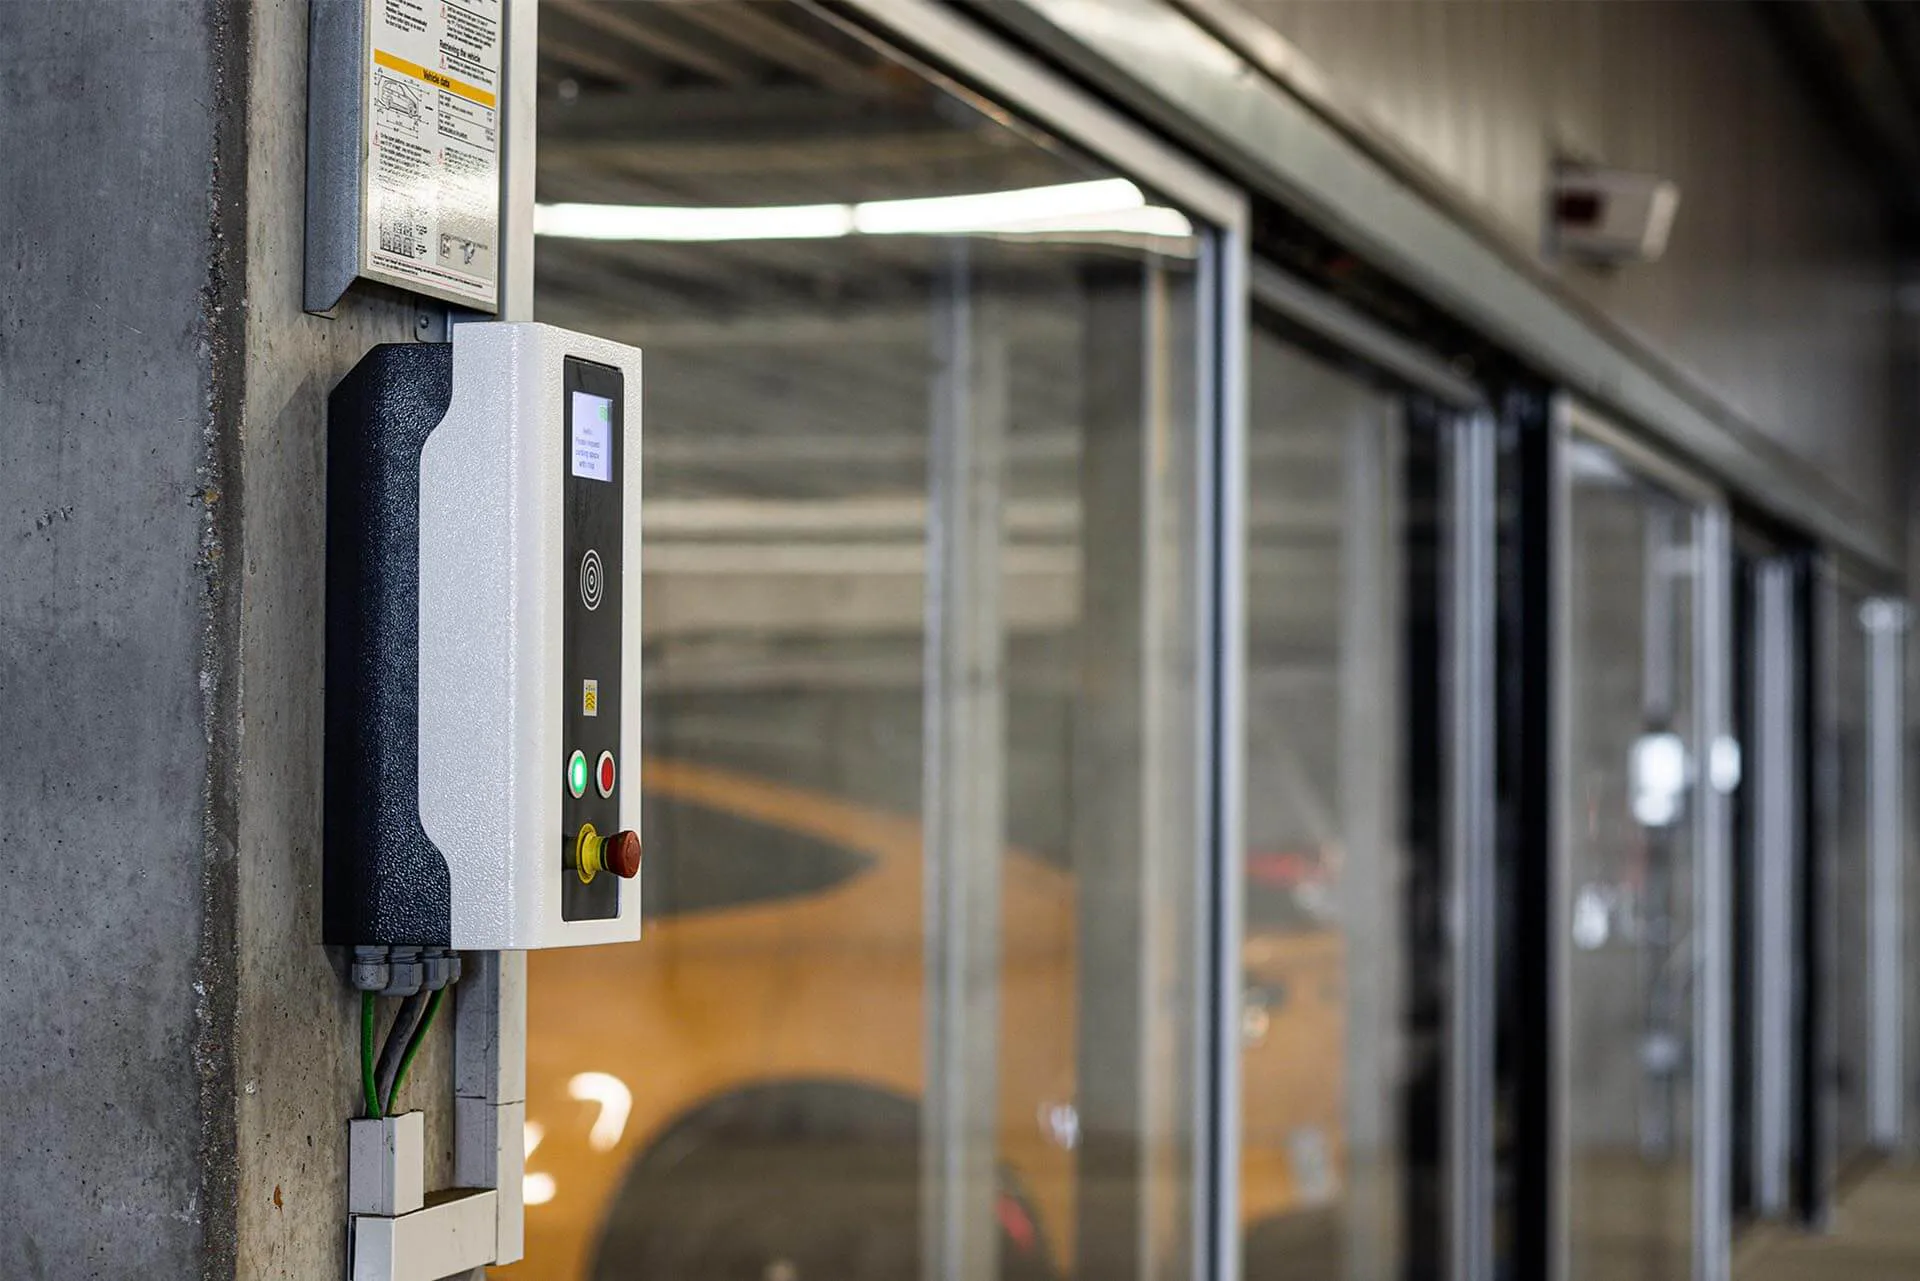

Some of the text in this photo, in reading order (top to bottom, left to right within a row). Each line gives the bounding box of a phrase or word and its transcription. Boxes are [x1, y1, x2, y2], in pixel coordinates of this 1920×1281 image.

[439, 39, 460, 57] Retrieving
[467, 50, 481, 63] vehicle
[423, 69, 440, 84] Vehicle
[440, 77, 450, 88] data
